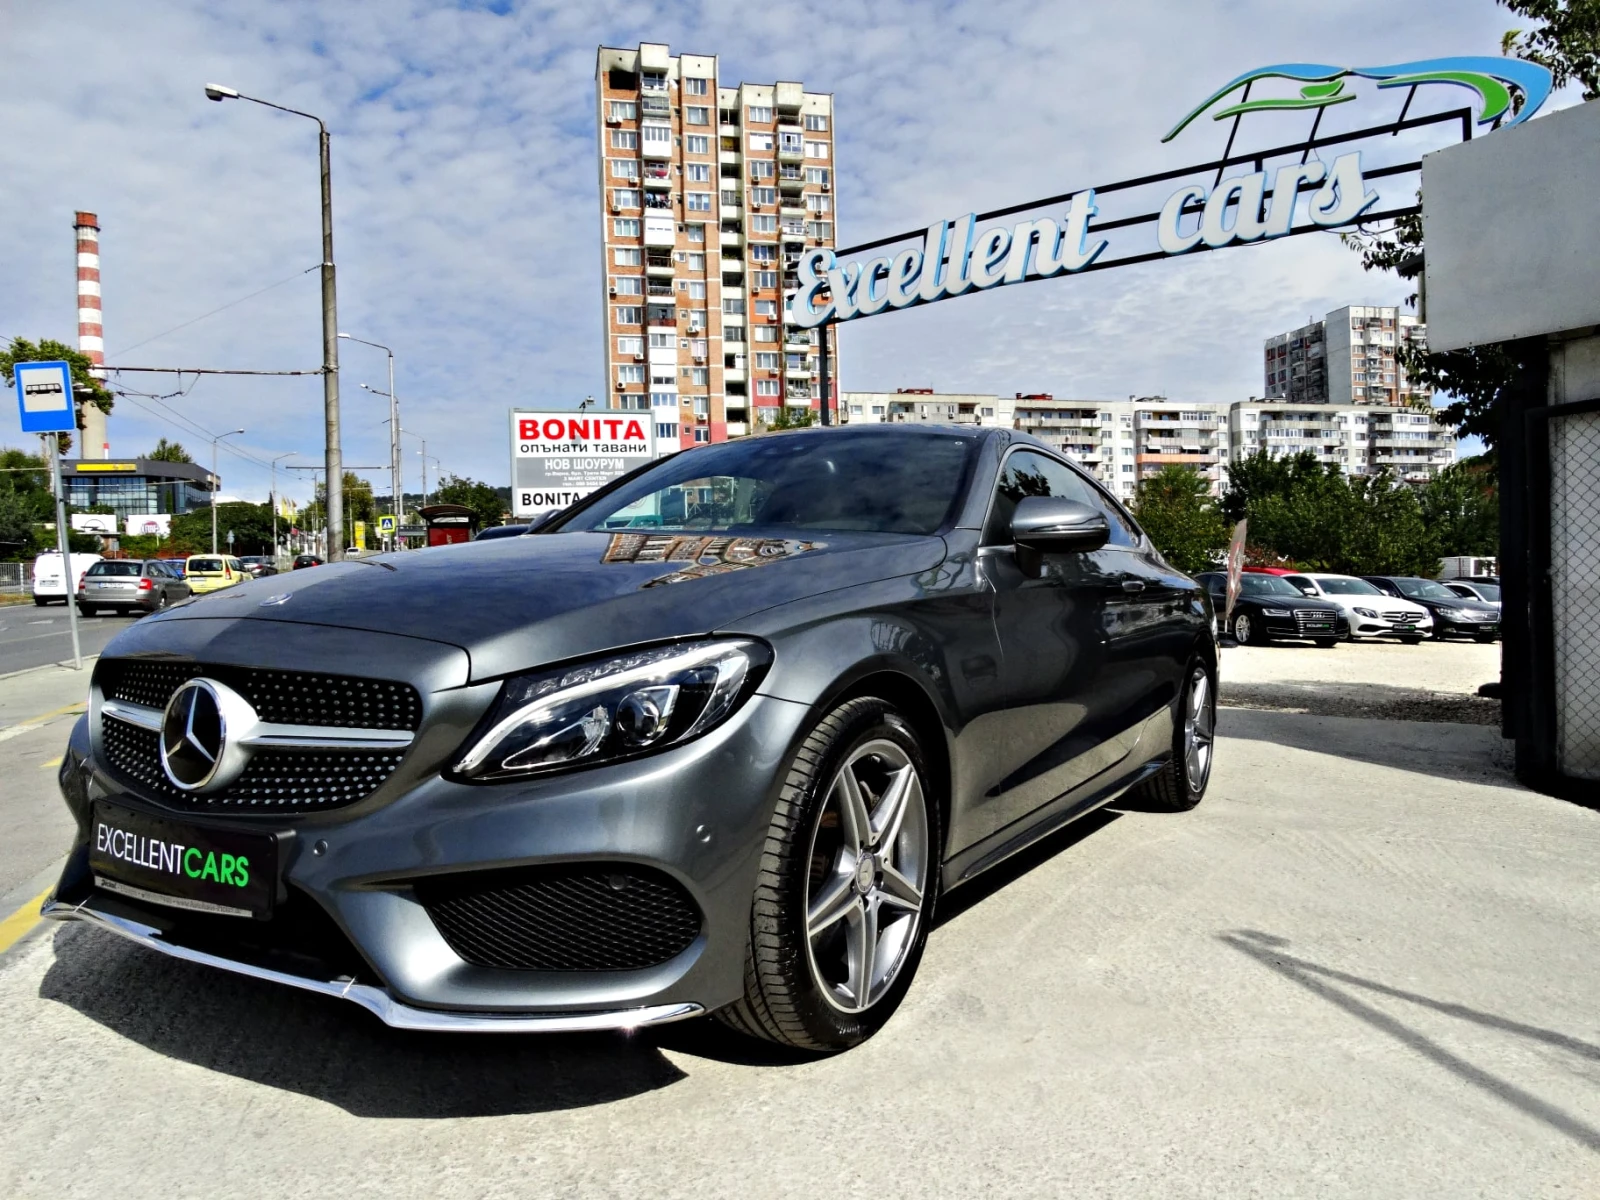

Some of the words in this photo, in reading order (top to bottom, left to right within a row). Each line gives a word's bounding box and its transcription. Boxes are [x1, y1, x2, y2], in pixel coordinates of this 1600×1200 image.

[791, 189, 1109, 327] Excellent
[1157, 151, 1380, 255] cars
[519, 419, 645, 440] BONITA
[520, 443, 588, 453] опънати
[593, 444, 647, 453] тавани
[545, 459, 570, 470] НОВ
[573, 459, 624, 470] ШОУРУМ
[522, 492, 580, 506] BONITA
